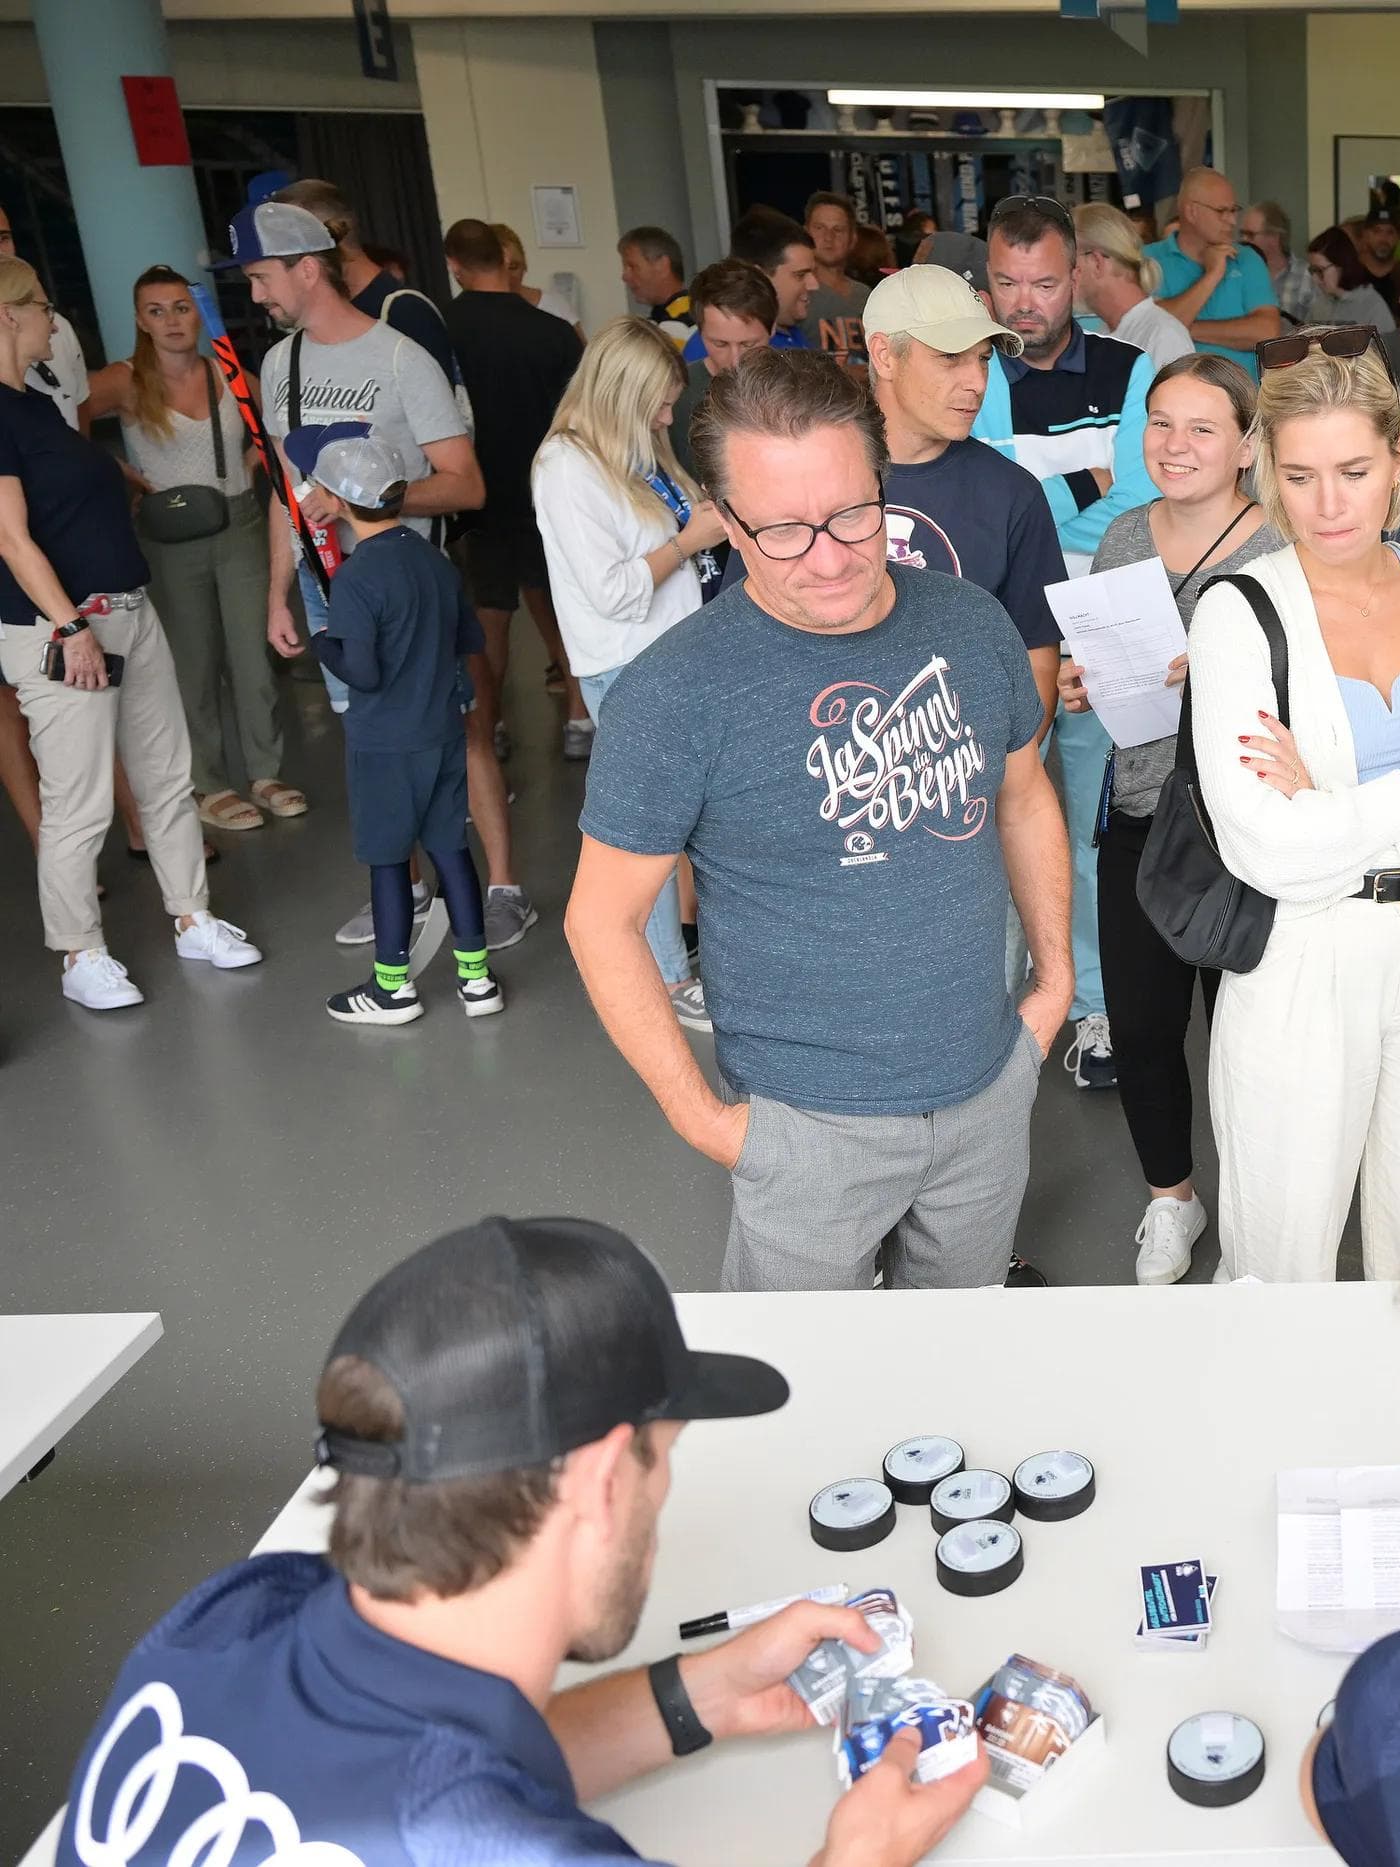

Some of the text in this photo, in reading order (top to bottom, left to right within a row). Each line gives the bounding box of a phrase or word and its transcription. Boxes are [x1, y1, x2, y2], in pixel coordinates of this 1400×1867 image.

[272, 375, 380, 413] Oiginals
[838, 725, 985, 832] Beppi
[913, 751, 932, 772] da
